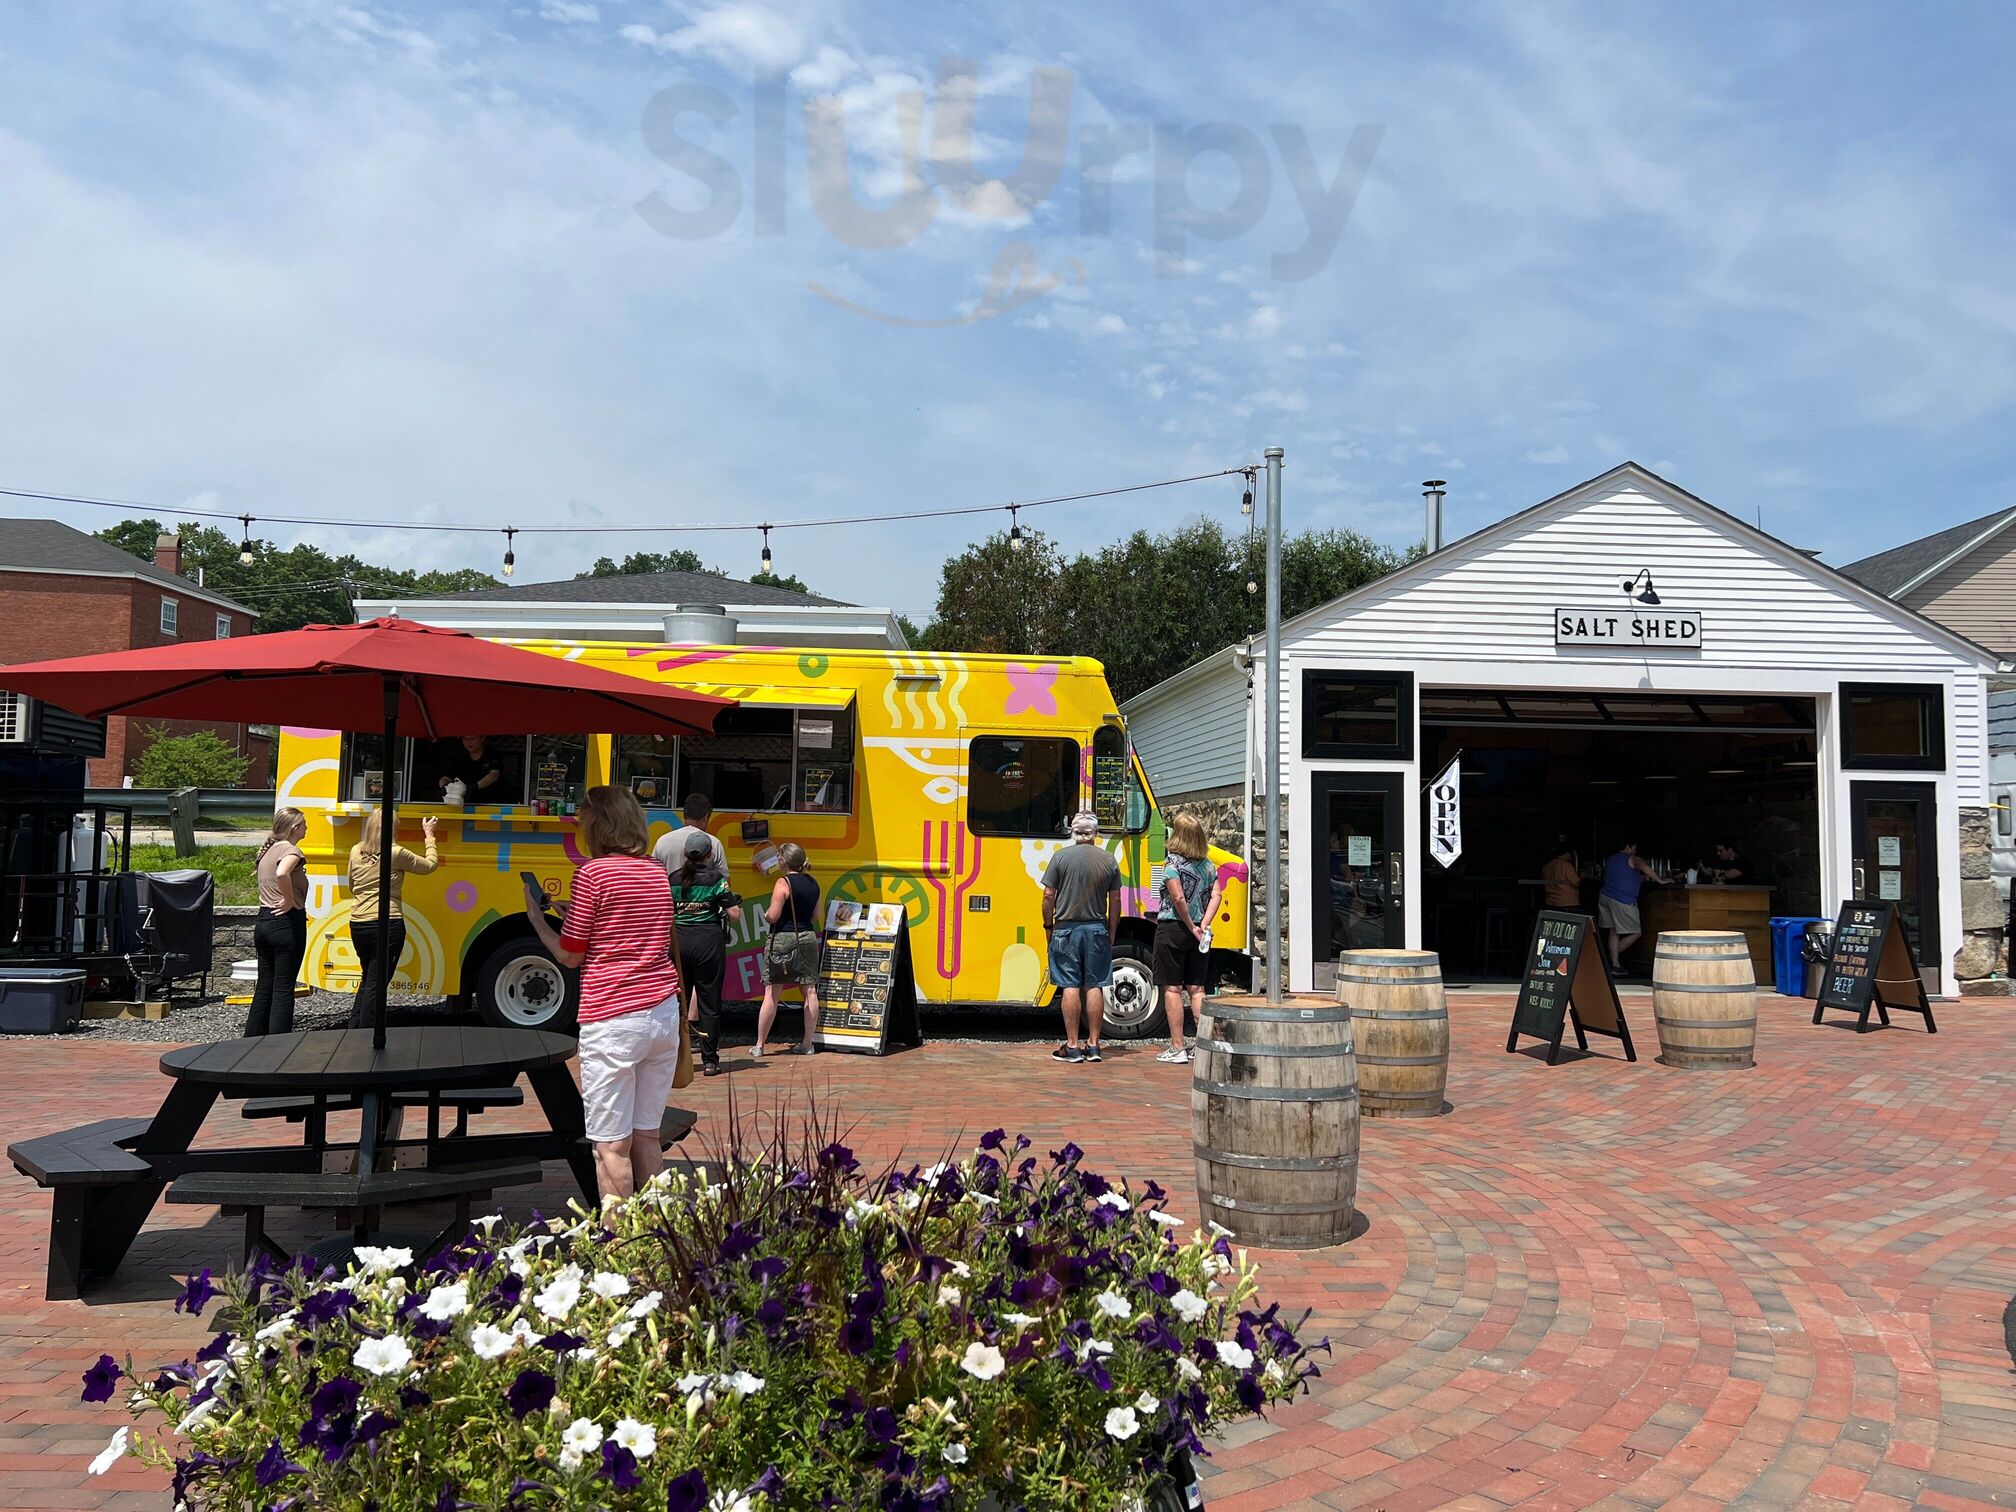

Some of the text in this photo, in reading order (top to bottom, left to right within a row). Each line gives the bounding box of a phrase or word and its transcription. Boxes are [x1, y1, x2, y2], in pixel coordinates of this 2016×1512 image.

[1561, 617, 1696, 639] SALT SHED
[1434, 784, 1457, 854] OPEN
[1543, 921, 1577, 940] TRY OUT OUR
[390, 982, 429, 990] 3865146
[1546, 982, 1555, 992] THE
[1833, 977, 1854, 994] BEER
